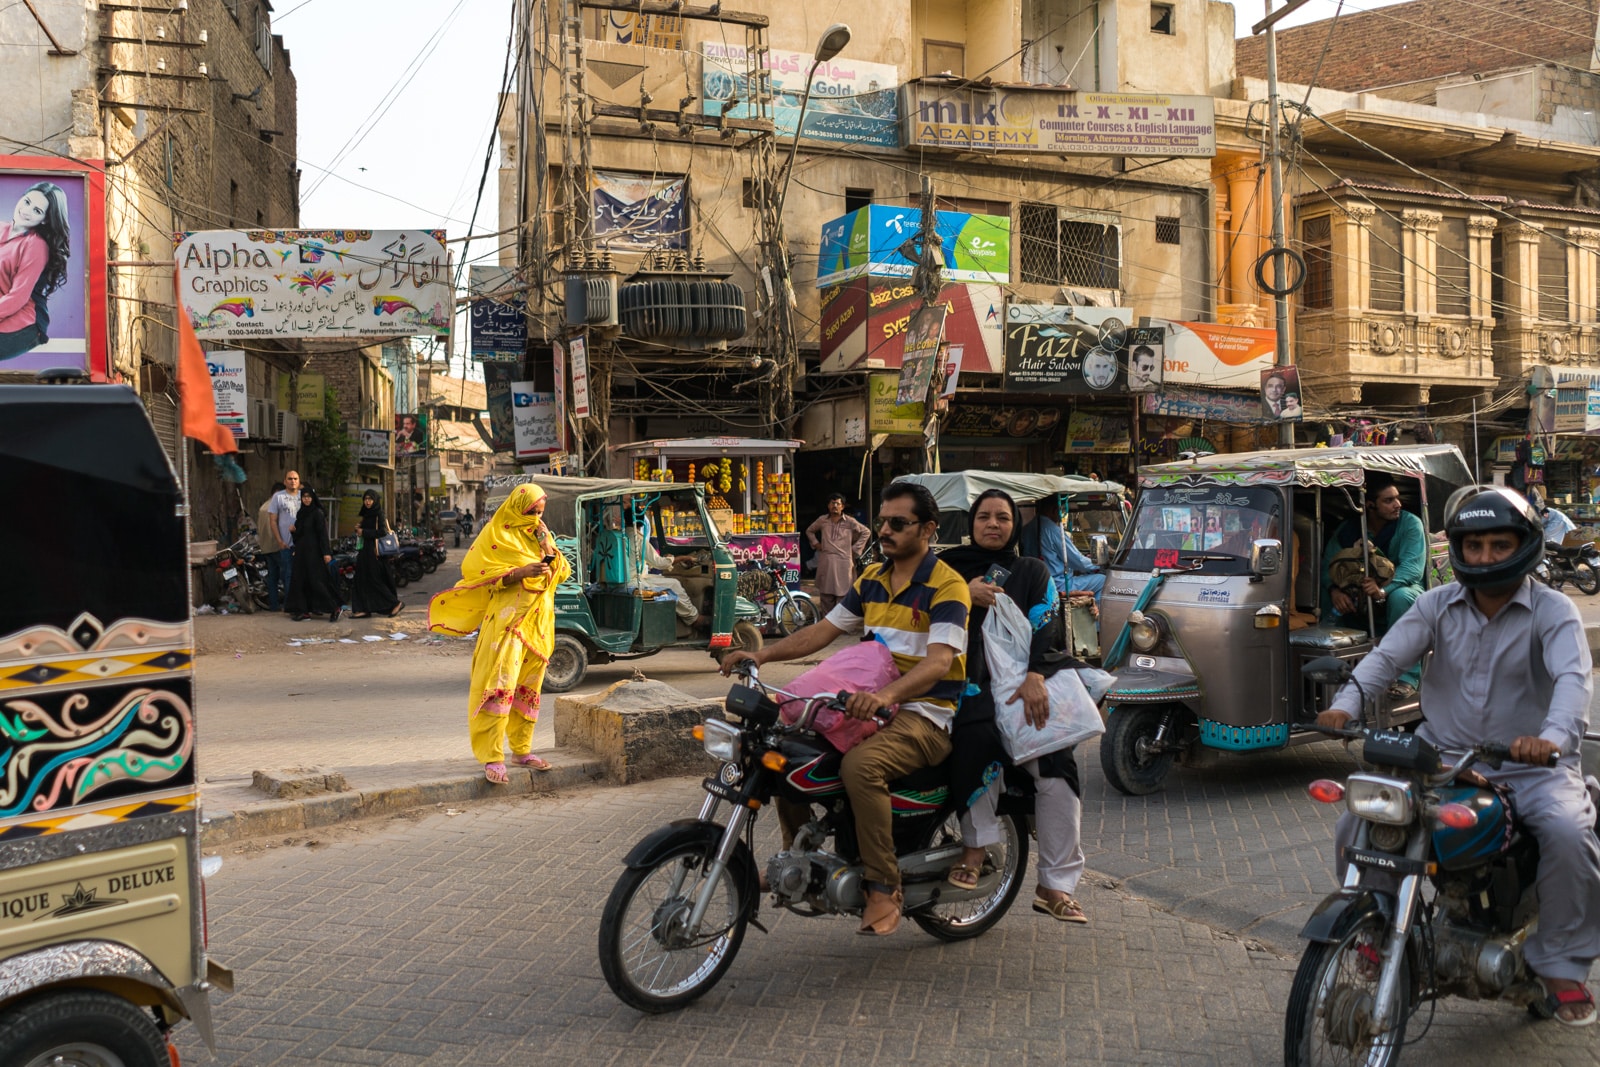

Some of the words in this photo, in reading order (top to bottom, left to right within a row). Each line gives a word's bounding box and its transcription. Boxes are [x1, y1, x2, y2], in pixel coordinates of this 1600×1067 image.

[816, 80, 851, 98] Gold
[920, 92, 999, 125] mik
[1089, 95, 1117, 104] Offering
[1057, 104, 1079, 118] IX
[1097, 105, 1111, 119] X
[1128, 106, 1149, 120] XI
[1167, 108, 1195, 121] XII
[920, 125, 1034, 143] ACADEMY
[1039, 119, 1085, 132] Computer
[1087, 120, 1125, 132] Courses
[1126, 122, 1132, 132] &
[1134, 121, 1168, 135] English
[1169, 123, 1212, 136] Language
[1056, 133, 1092, 144] Morning,
[1093, 134, 1130, 144] Afternoon
[1133, 135, 1139, 144] &
[1141, 135, 1171, 146] Evening
[1172, 136, 1198, 145] Classes
[183, 242, 273, 275] Alpha
[191, 275, 269, 297] Graphics
[869, 289, 893, 308] Jazz
[235, 321, 265, 329] Contact:
[825, 319, 840, 341] Syed
[839, 305, 855, 326] Azan
[1009, 323, 1084, 358] Fazi
[1018, 357, 1046, 371] Hair
[1048, 357, 1081, 371] Saloon
[1459, 509, 1496, 521] HONDA
[1355, 853, 1396, 868] HONDA
[108, 866, 176, 894] DELUXE
